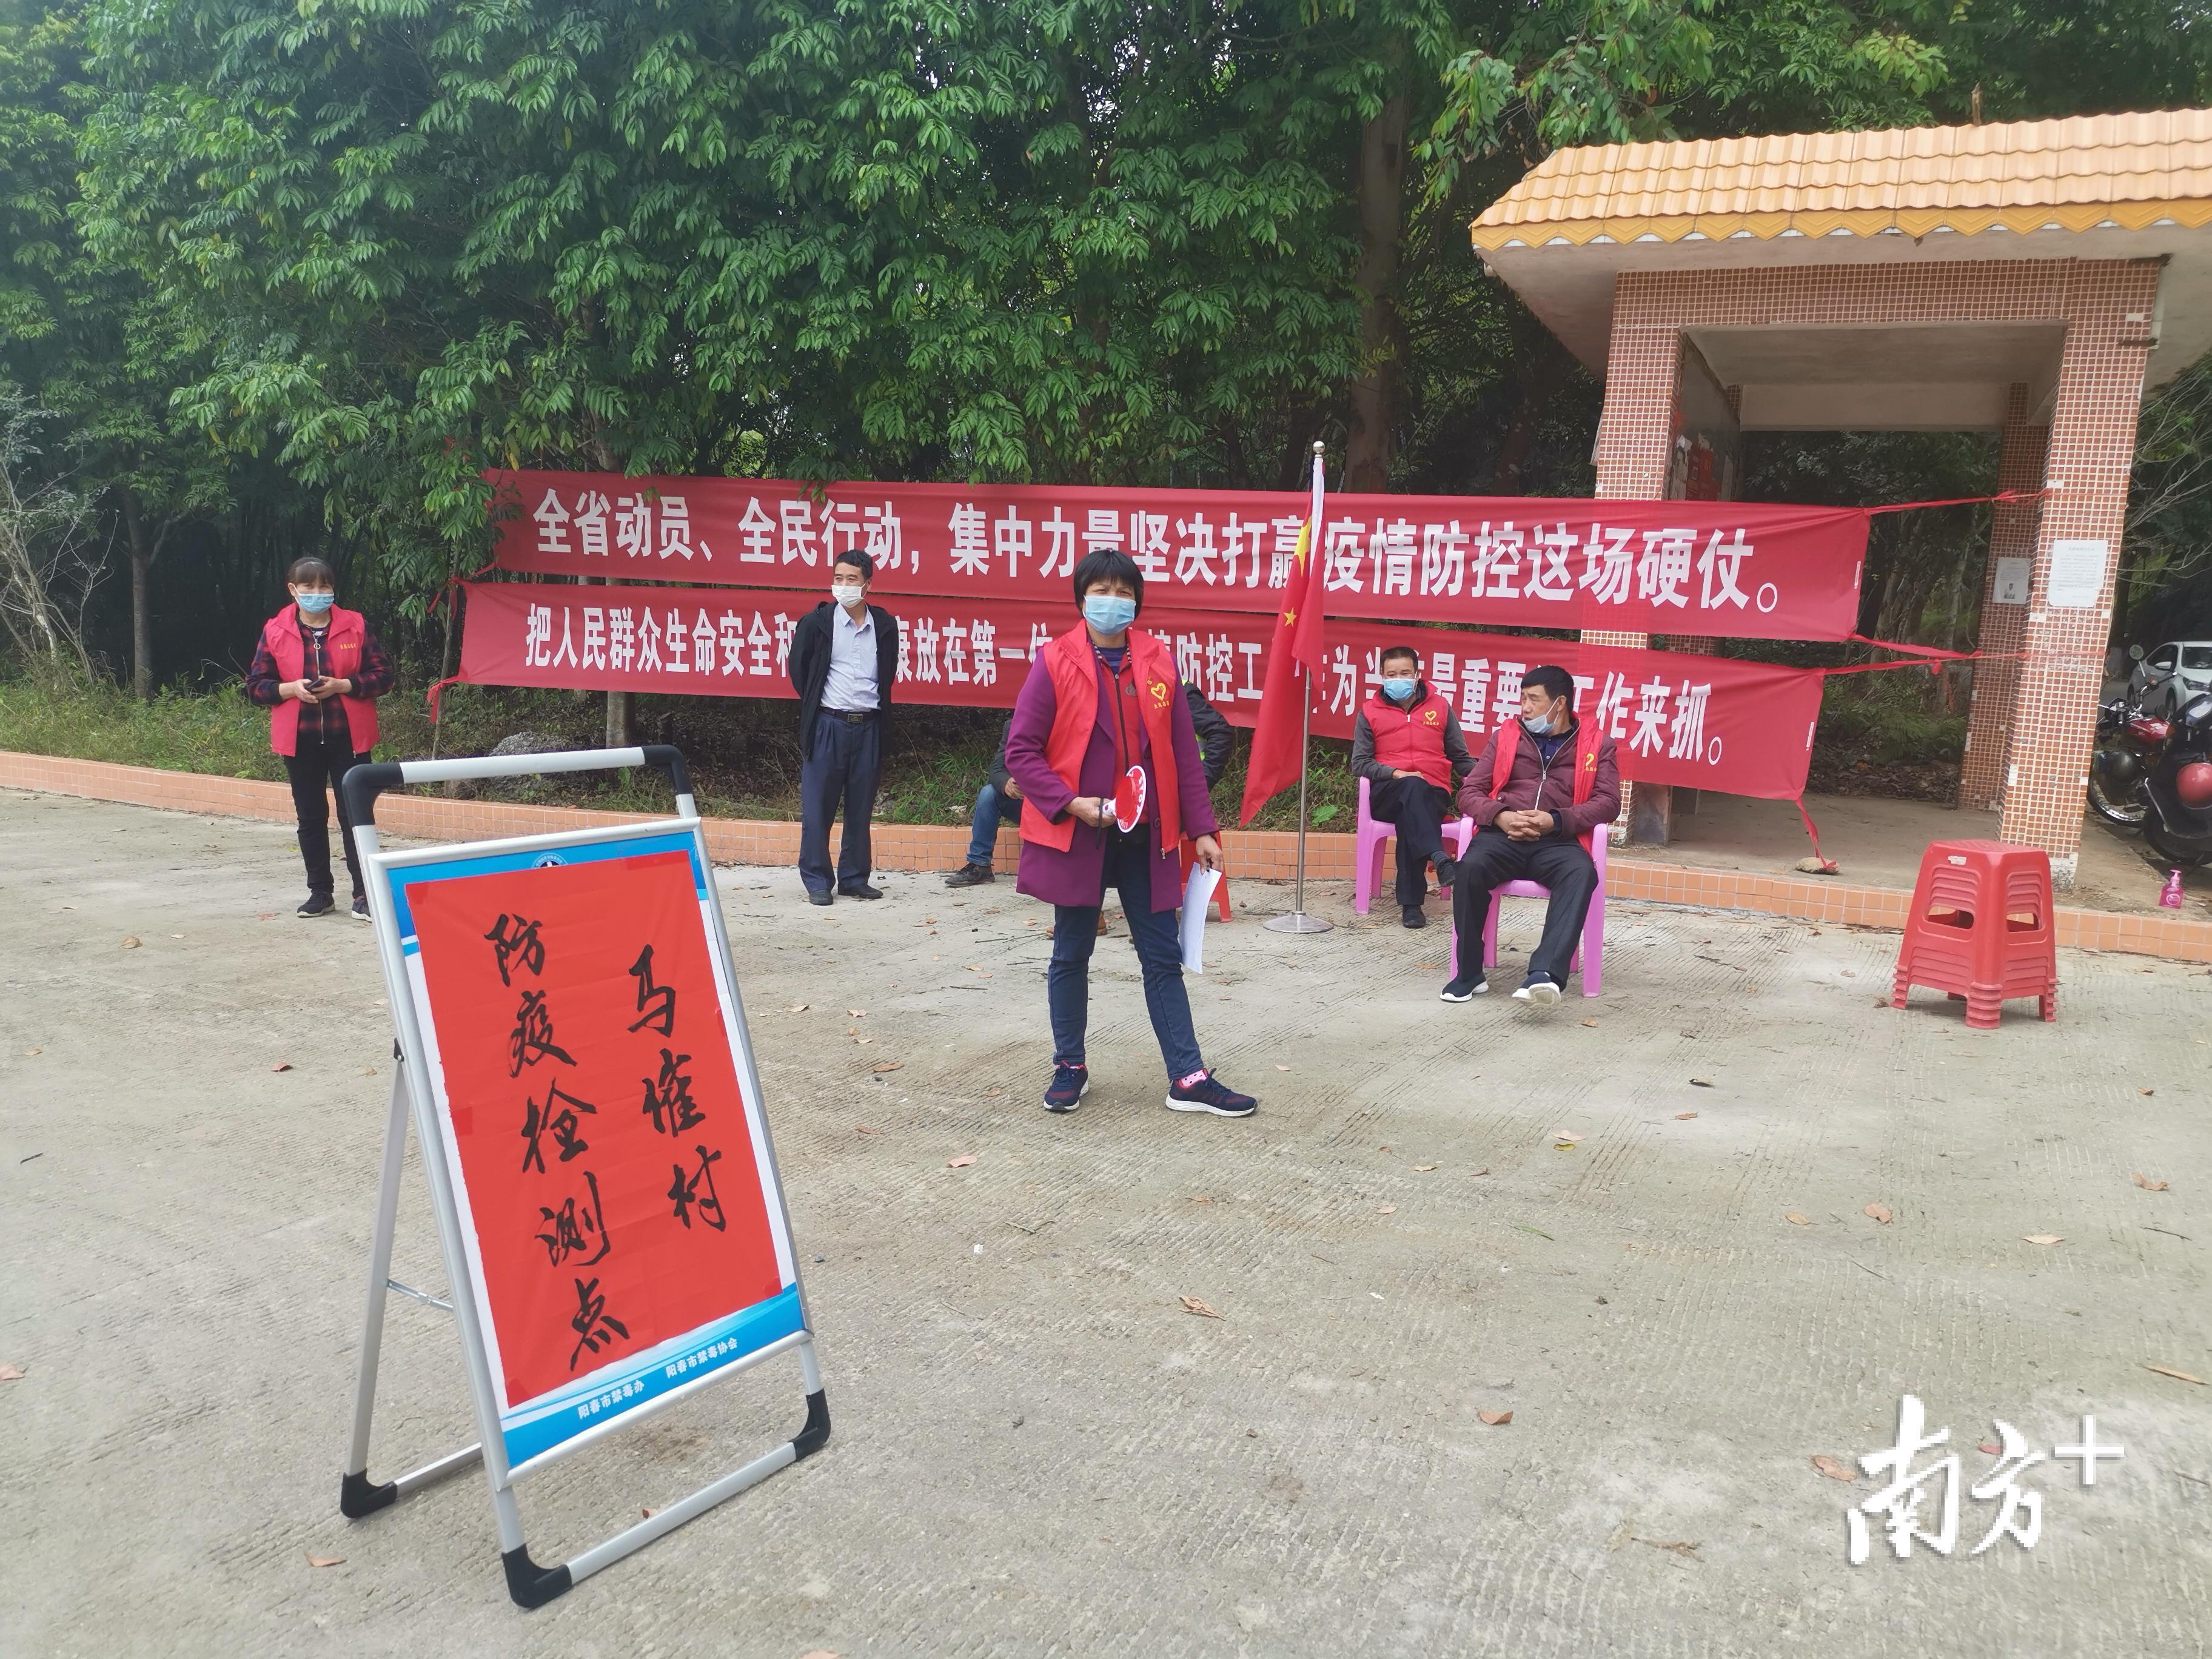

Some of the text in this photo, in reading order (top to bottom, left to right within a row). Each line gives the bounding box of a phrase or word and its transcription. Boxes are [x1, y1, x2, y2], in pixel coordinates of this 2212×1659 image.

[577, 1336, 738, 1420] 阳春市禁毒办 阳春市禁毒协会
